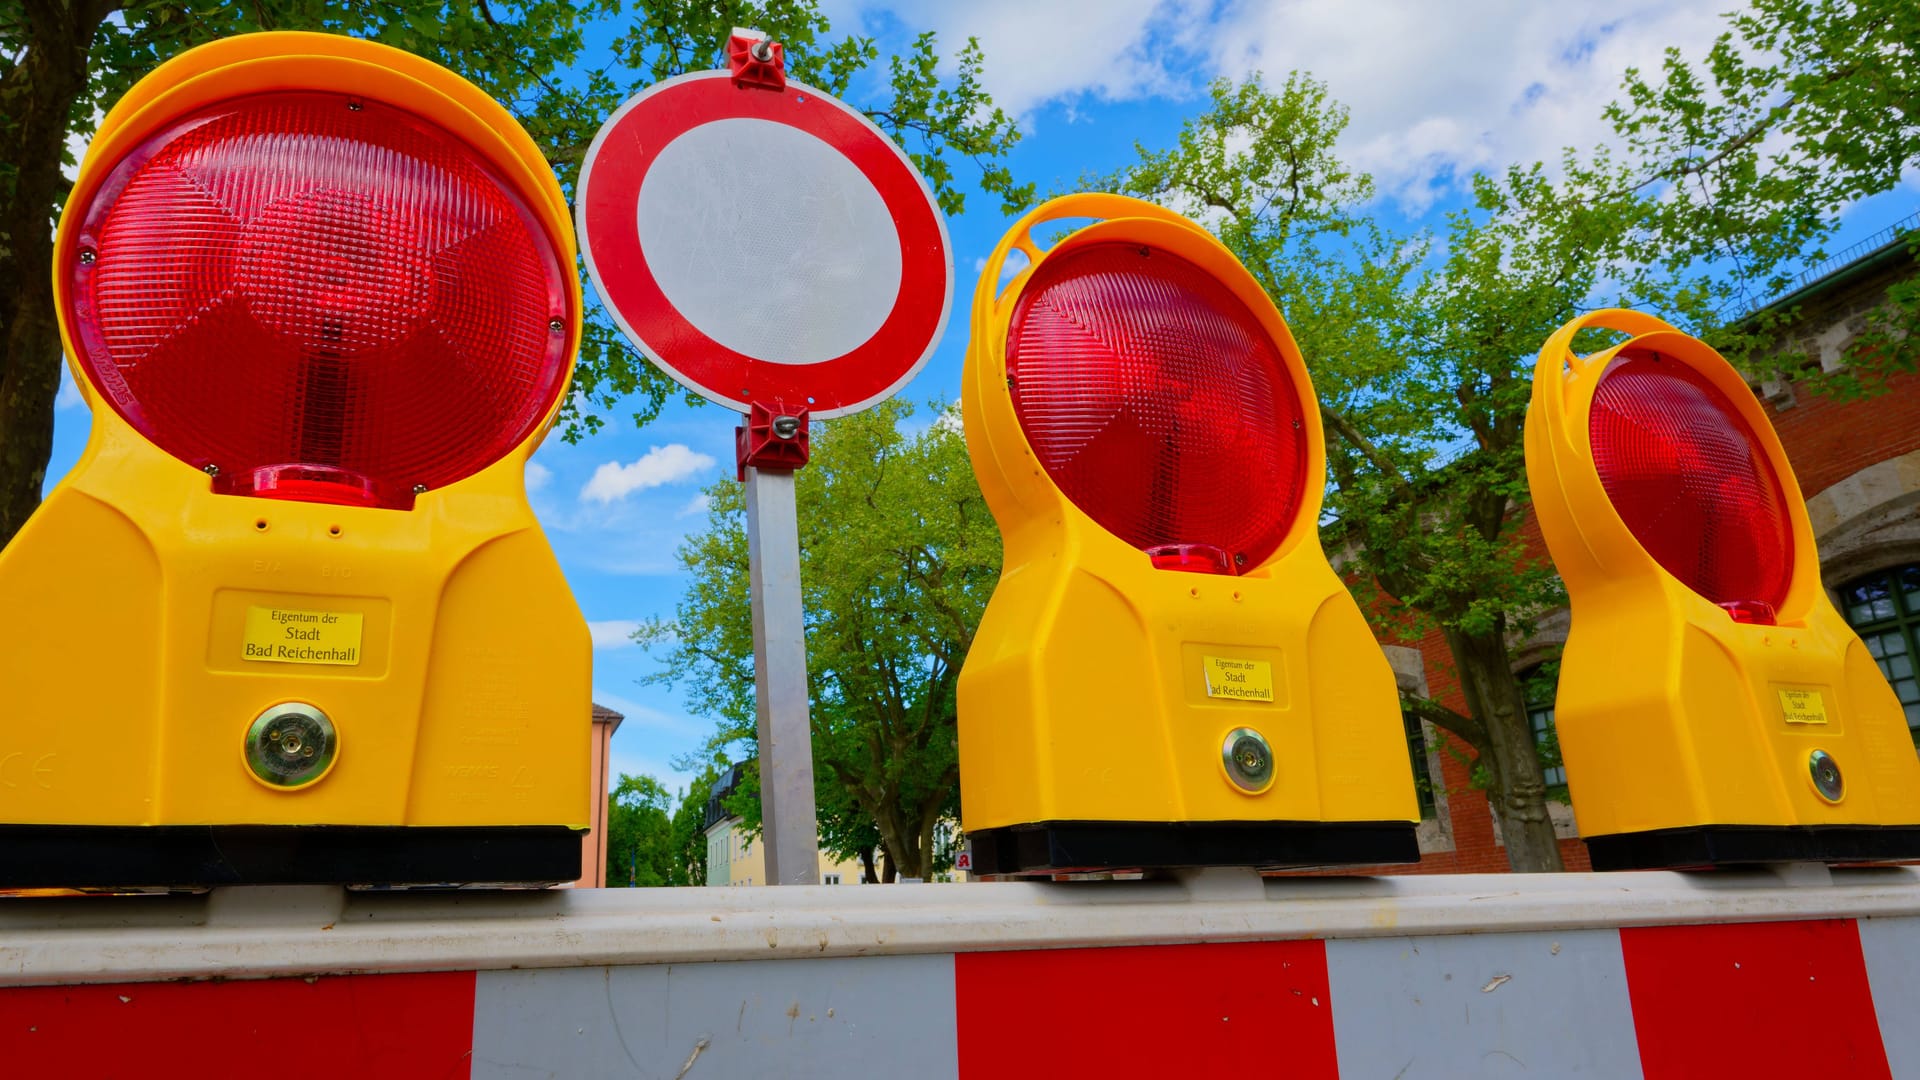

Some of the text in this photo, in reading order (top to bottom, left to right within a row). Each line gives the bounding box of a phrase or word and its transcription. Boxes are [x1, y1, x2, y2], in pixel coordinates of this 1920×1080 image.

[271, 610, 339, 625] Eigentum der
[285, 626, 321, 641] Stadt
[246, 643, 355, 661] Bad Reichenhall
[1215, 658, 1255, 670] Eigentum der
[1224, 671, 1247, 683] Stadt
[1223, 685, 1271, 699] Reichenhall
